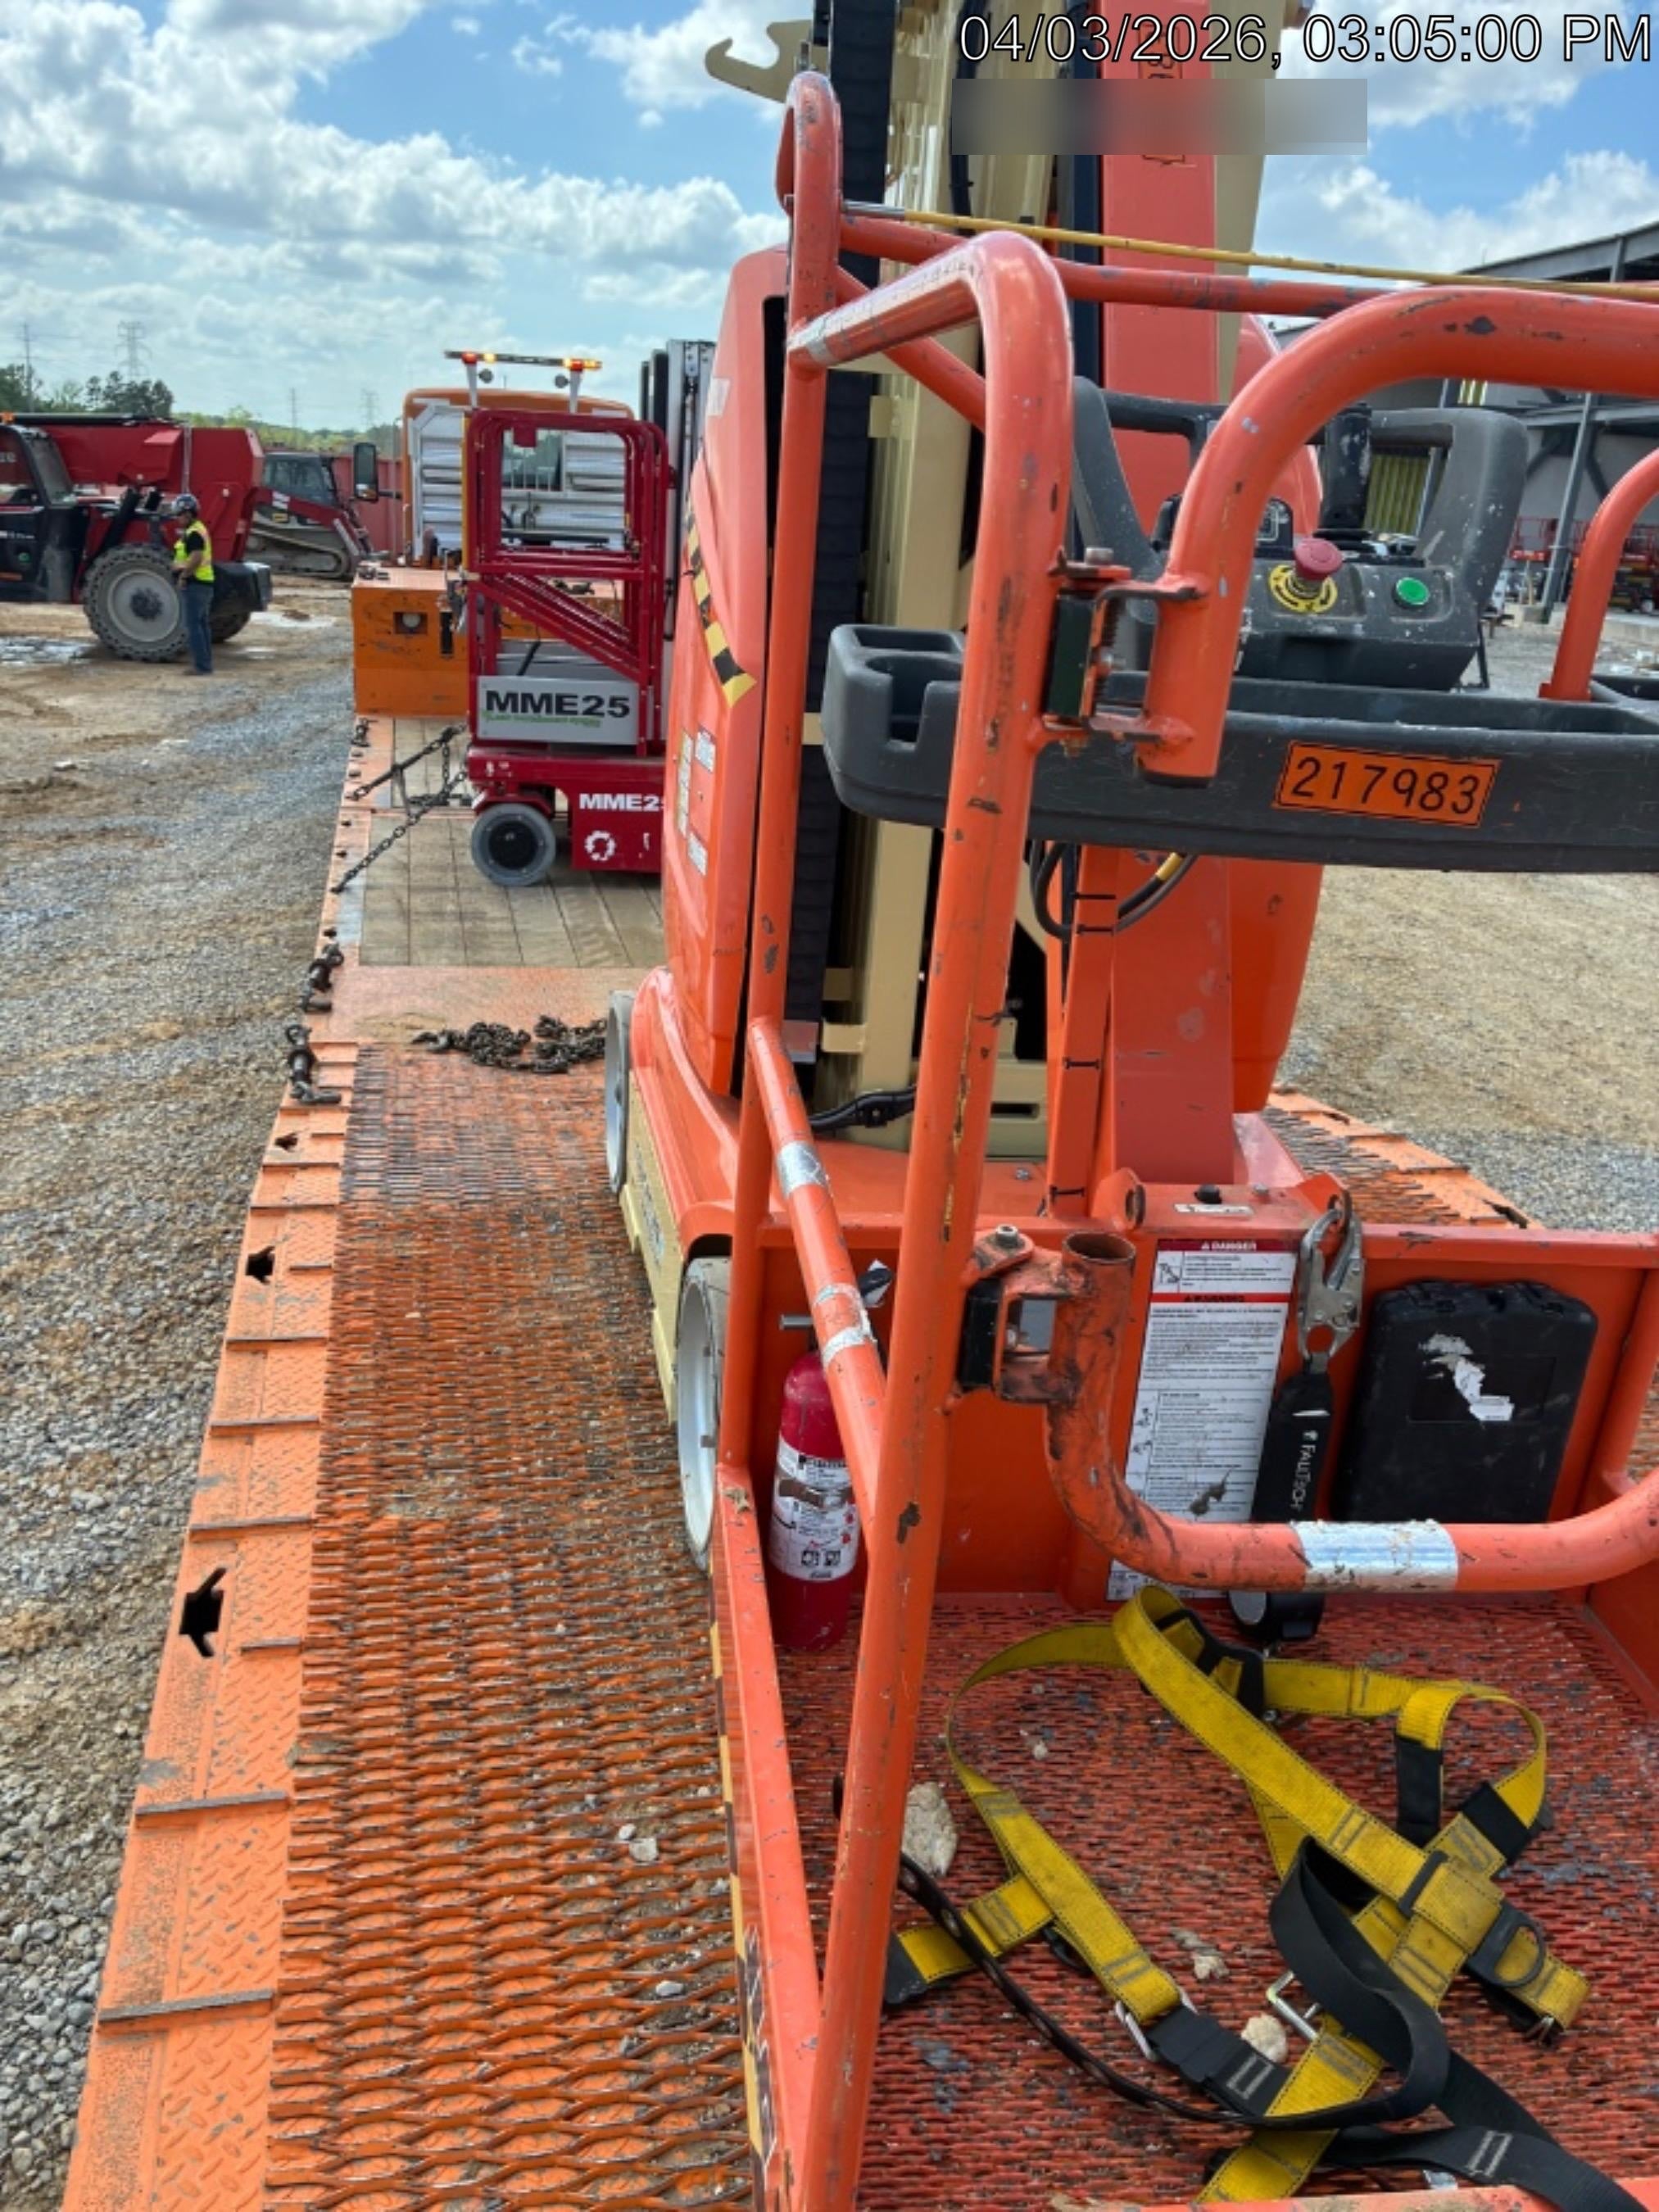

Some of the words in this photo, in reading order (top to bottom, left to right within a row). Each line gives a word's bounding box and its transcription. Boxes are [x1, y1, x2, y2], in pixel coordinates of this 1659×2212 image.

[486, 691, 629, 718] MME25
[1292, 757, 1479, 814] 217983
[580, 793, 664, 810] MME2
